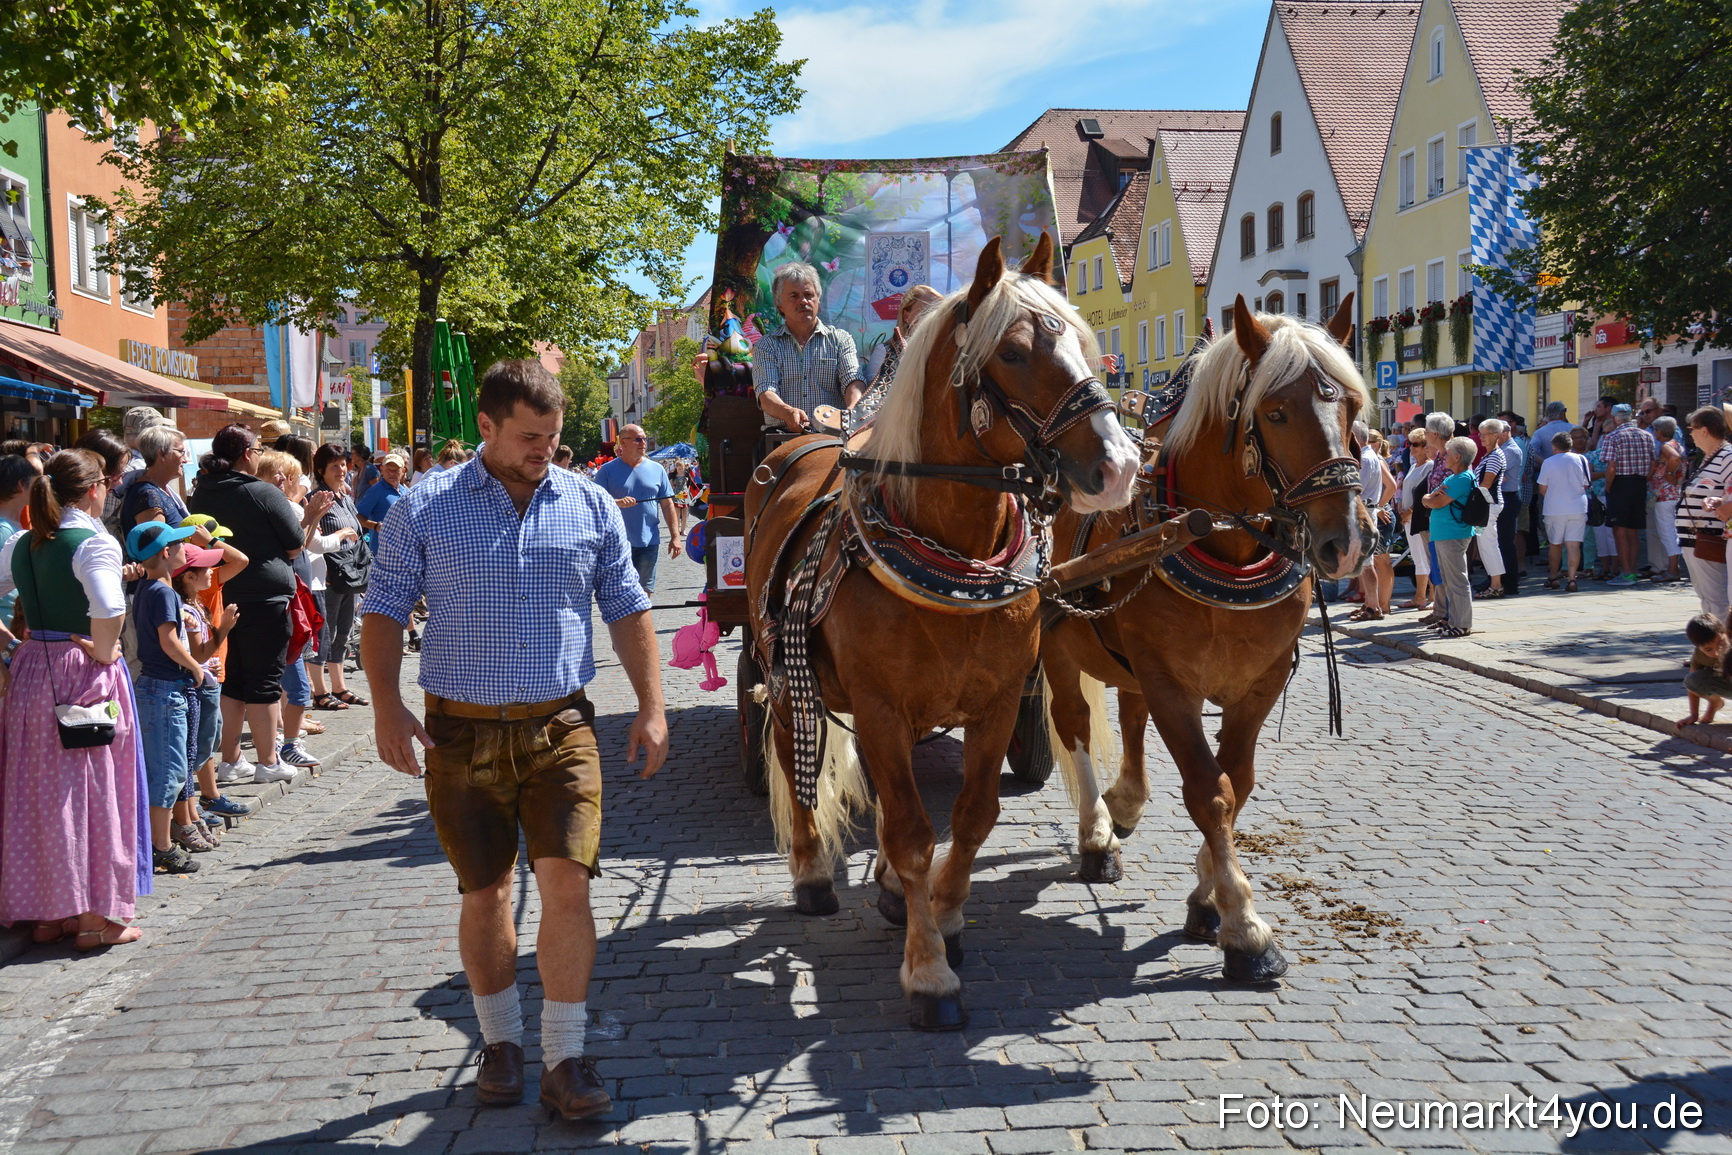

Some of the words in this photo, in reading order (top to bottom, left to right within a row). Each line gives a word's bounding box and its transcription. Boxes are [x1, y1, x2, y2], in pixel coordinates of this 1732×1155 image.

[1087, 310, 1104, 327] HOTEL
[1108, 306, 1128, 321] Lehmeier
[1545, 335, 1556, 346] KINO
[127, 340, 152, 371] LEDER
[1381, 365, 1393, 386] P
[330, 382, 346, 394] H&M
